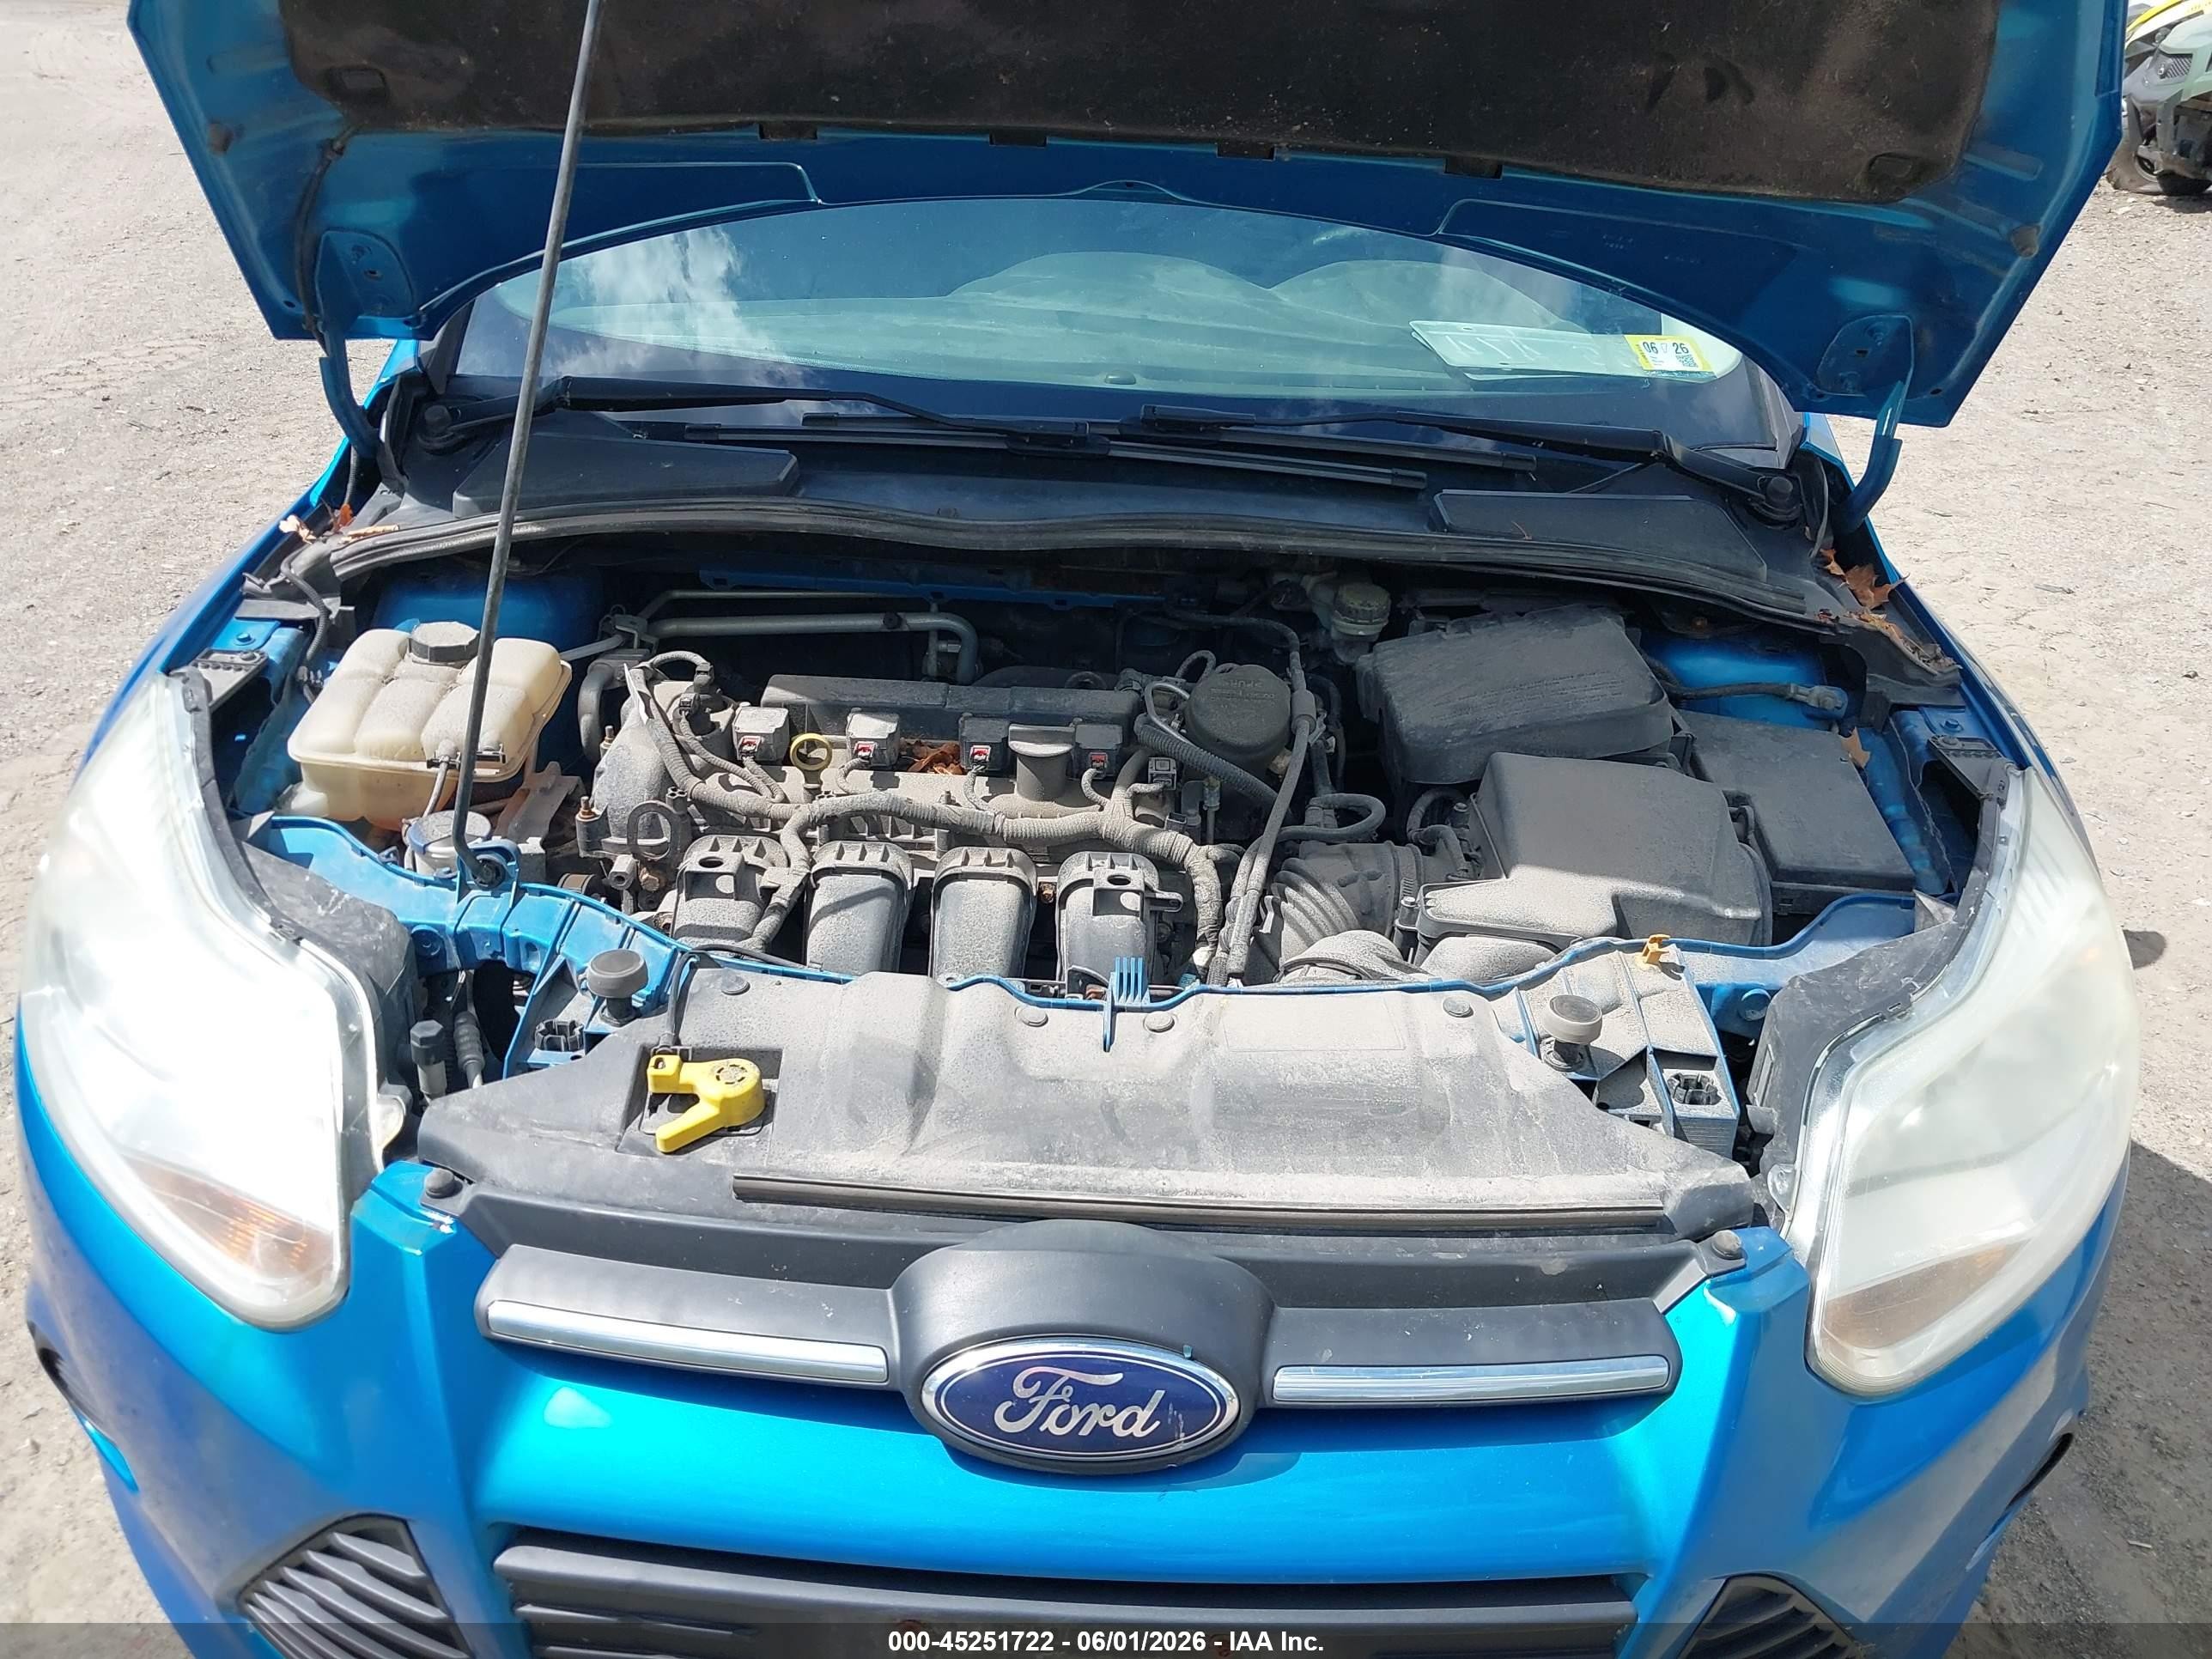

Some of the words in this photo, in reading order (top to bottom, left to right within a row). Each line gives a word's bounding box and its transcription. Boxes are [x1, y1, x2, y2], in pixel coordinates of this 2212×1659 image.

[1642, 342, 1659, 355] 06
[1672, 342, 1690, 355] 26
[994, 1365, 1166, 1437] Ford
